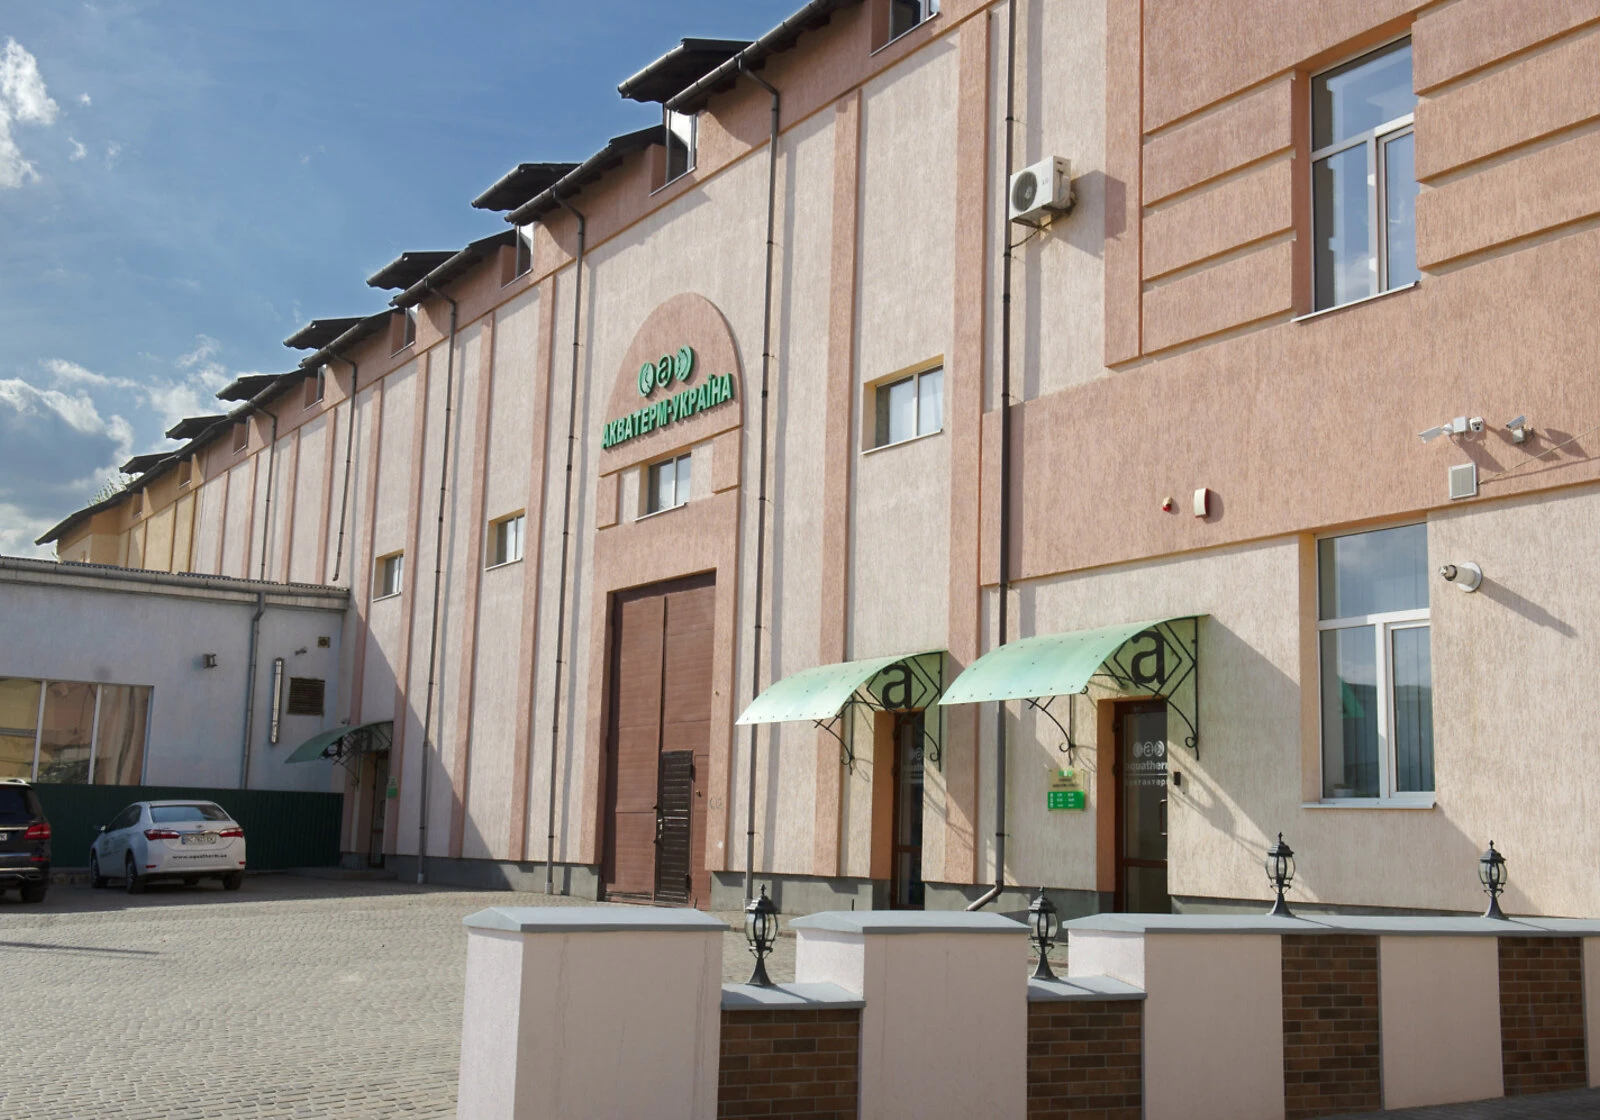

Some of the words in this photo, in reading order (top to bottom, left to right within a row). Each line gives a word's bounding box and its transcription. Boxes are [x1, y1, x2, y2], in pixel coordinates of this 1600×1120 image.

[601, 373, 733, 450] АКВАТЕРМ-УКРАЇНА
[1131, 631, 1165, 684] a
[882, 664, 912, 709] a
